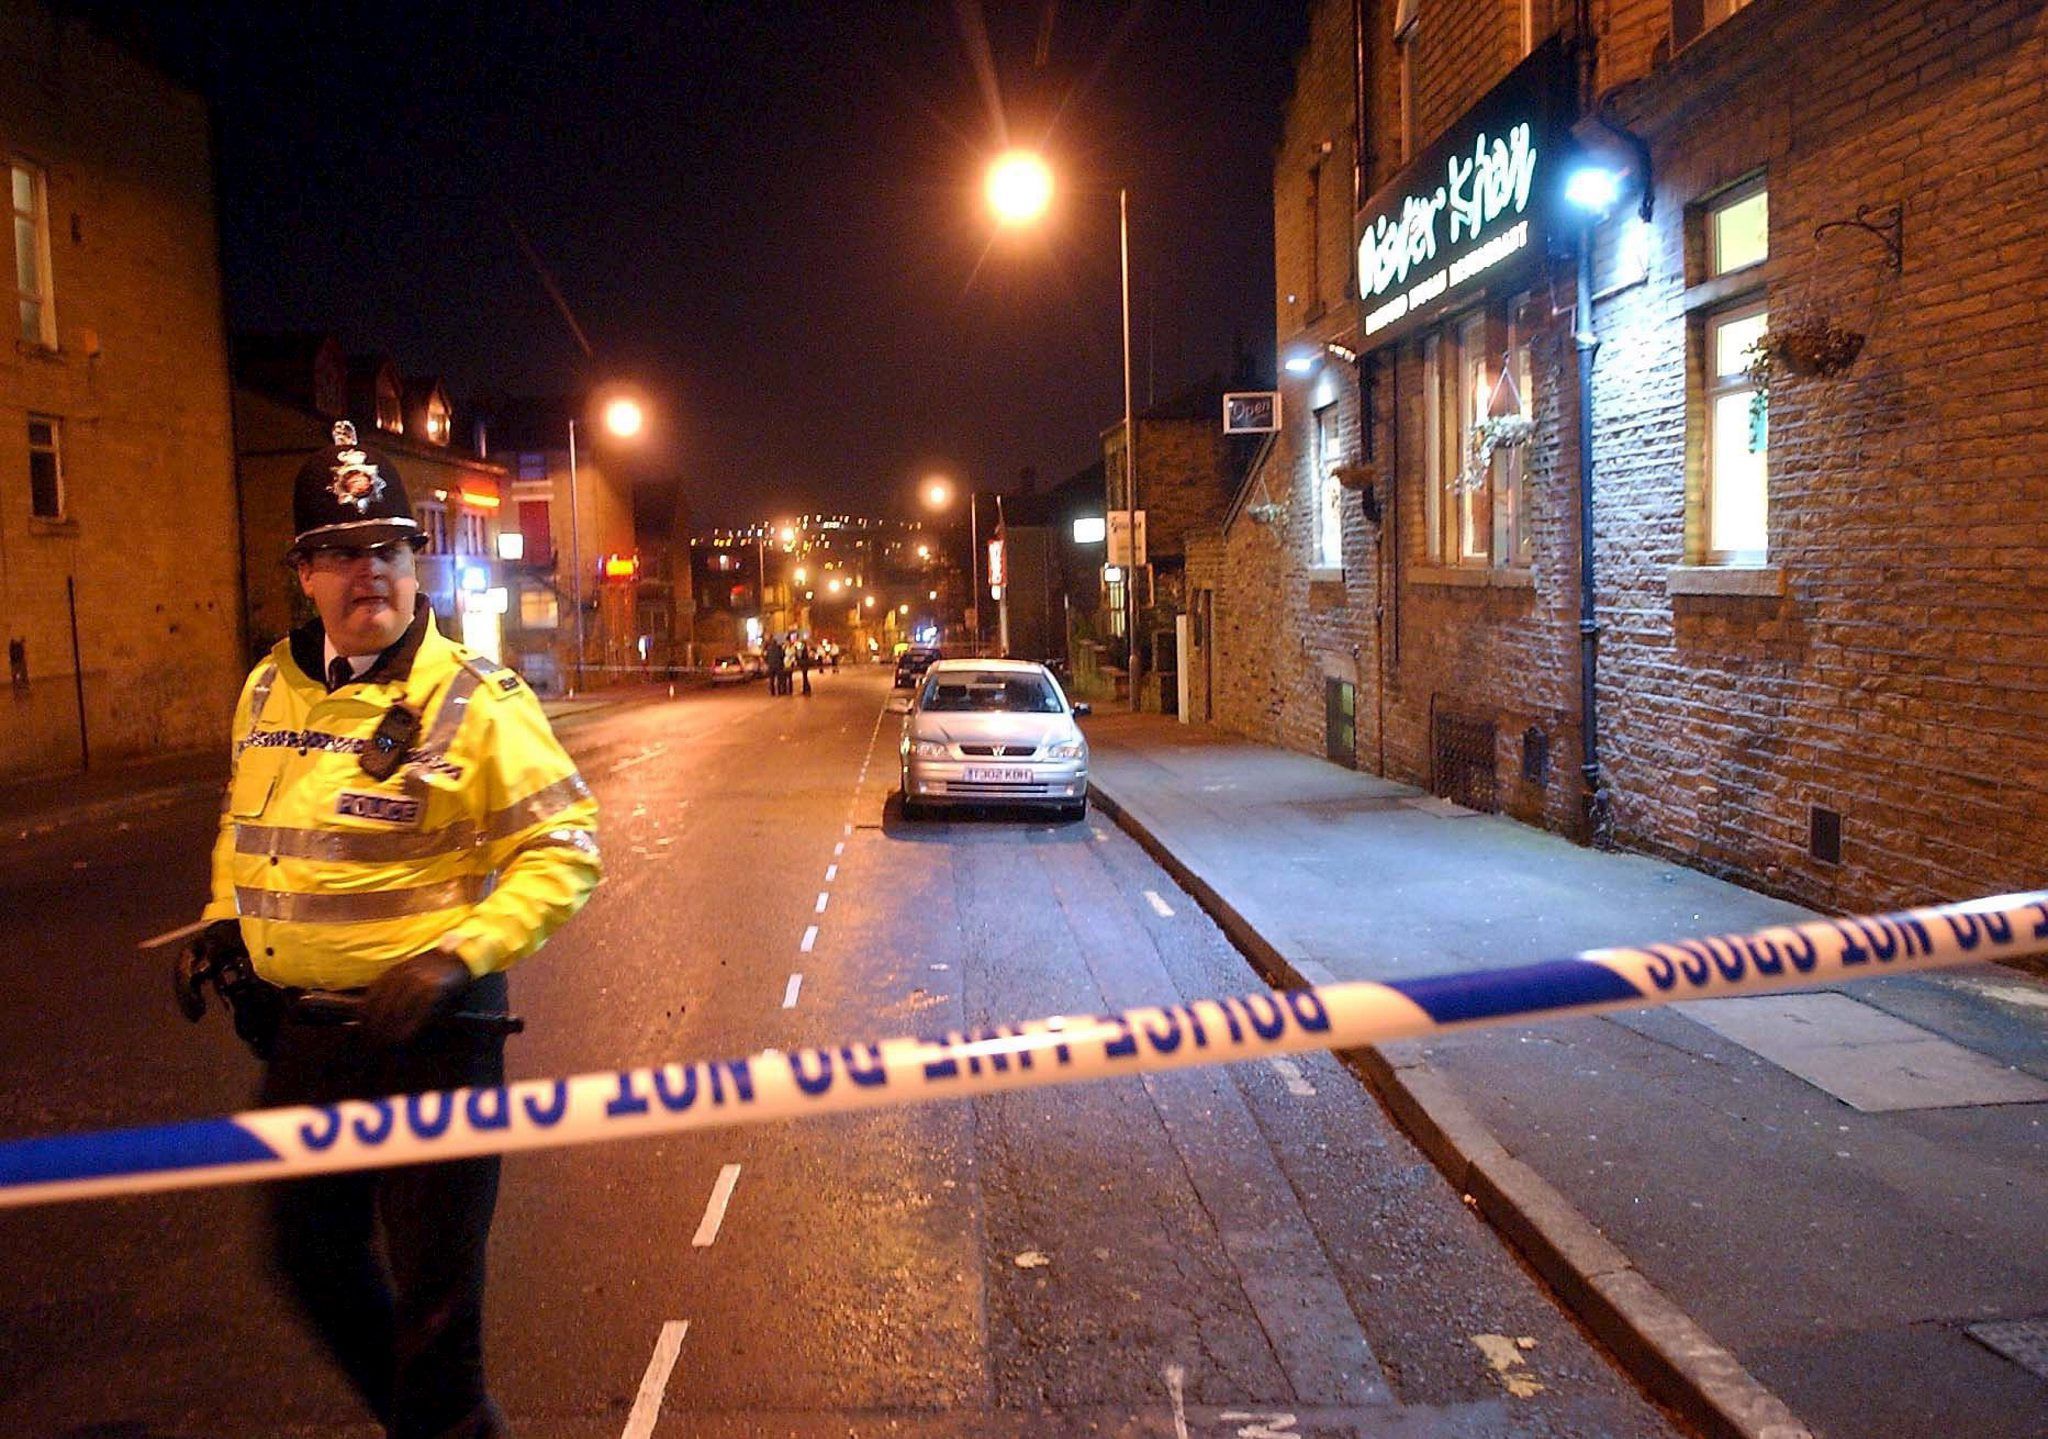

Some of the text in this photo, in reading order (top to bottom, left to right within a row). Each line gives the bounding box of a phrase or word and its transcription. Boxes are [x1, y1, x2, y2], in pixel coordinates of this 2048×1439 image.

[1232, 400, 1271, 425] Open
[339, 794, 418, 822] POLICE
[1103, 988, 1329, 1057] POLICE
[606, 1059, 755, 1118] NOT
[789, 1041, 887, 1096] DO
[299, 1079, 569, 1153] CROSS
